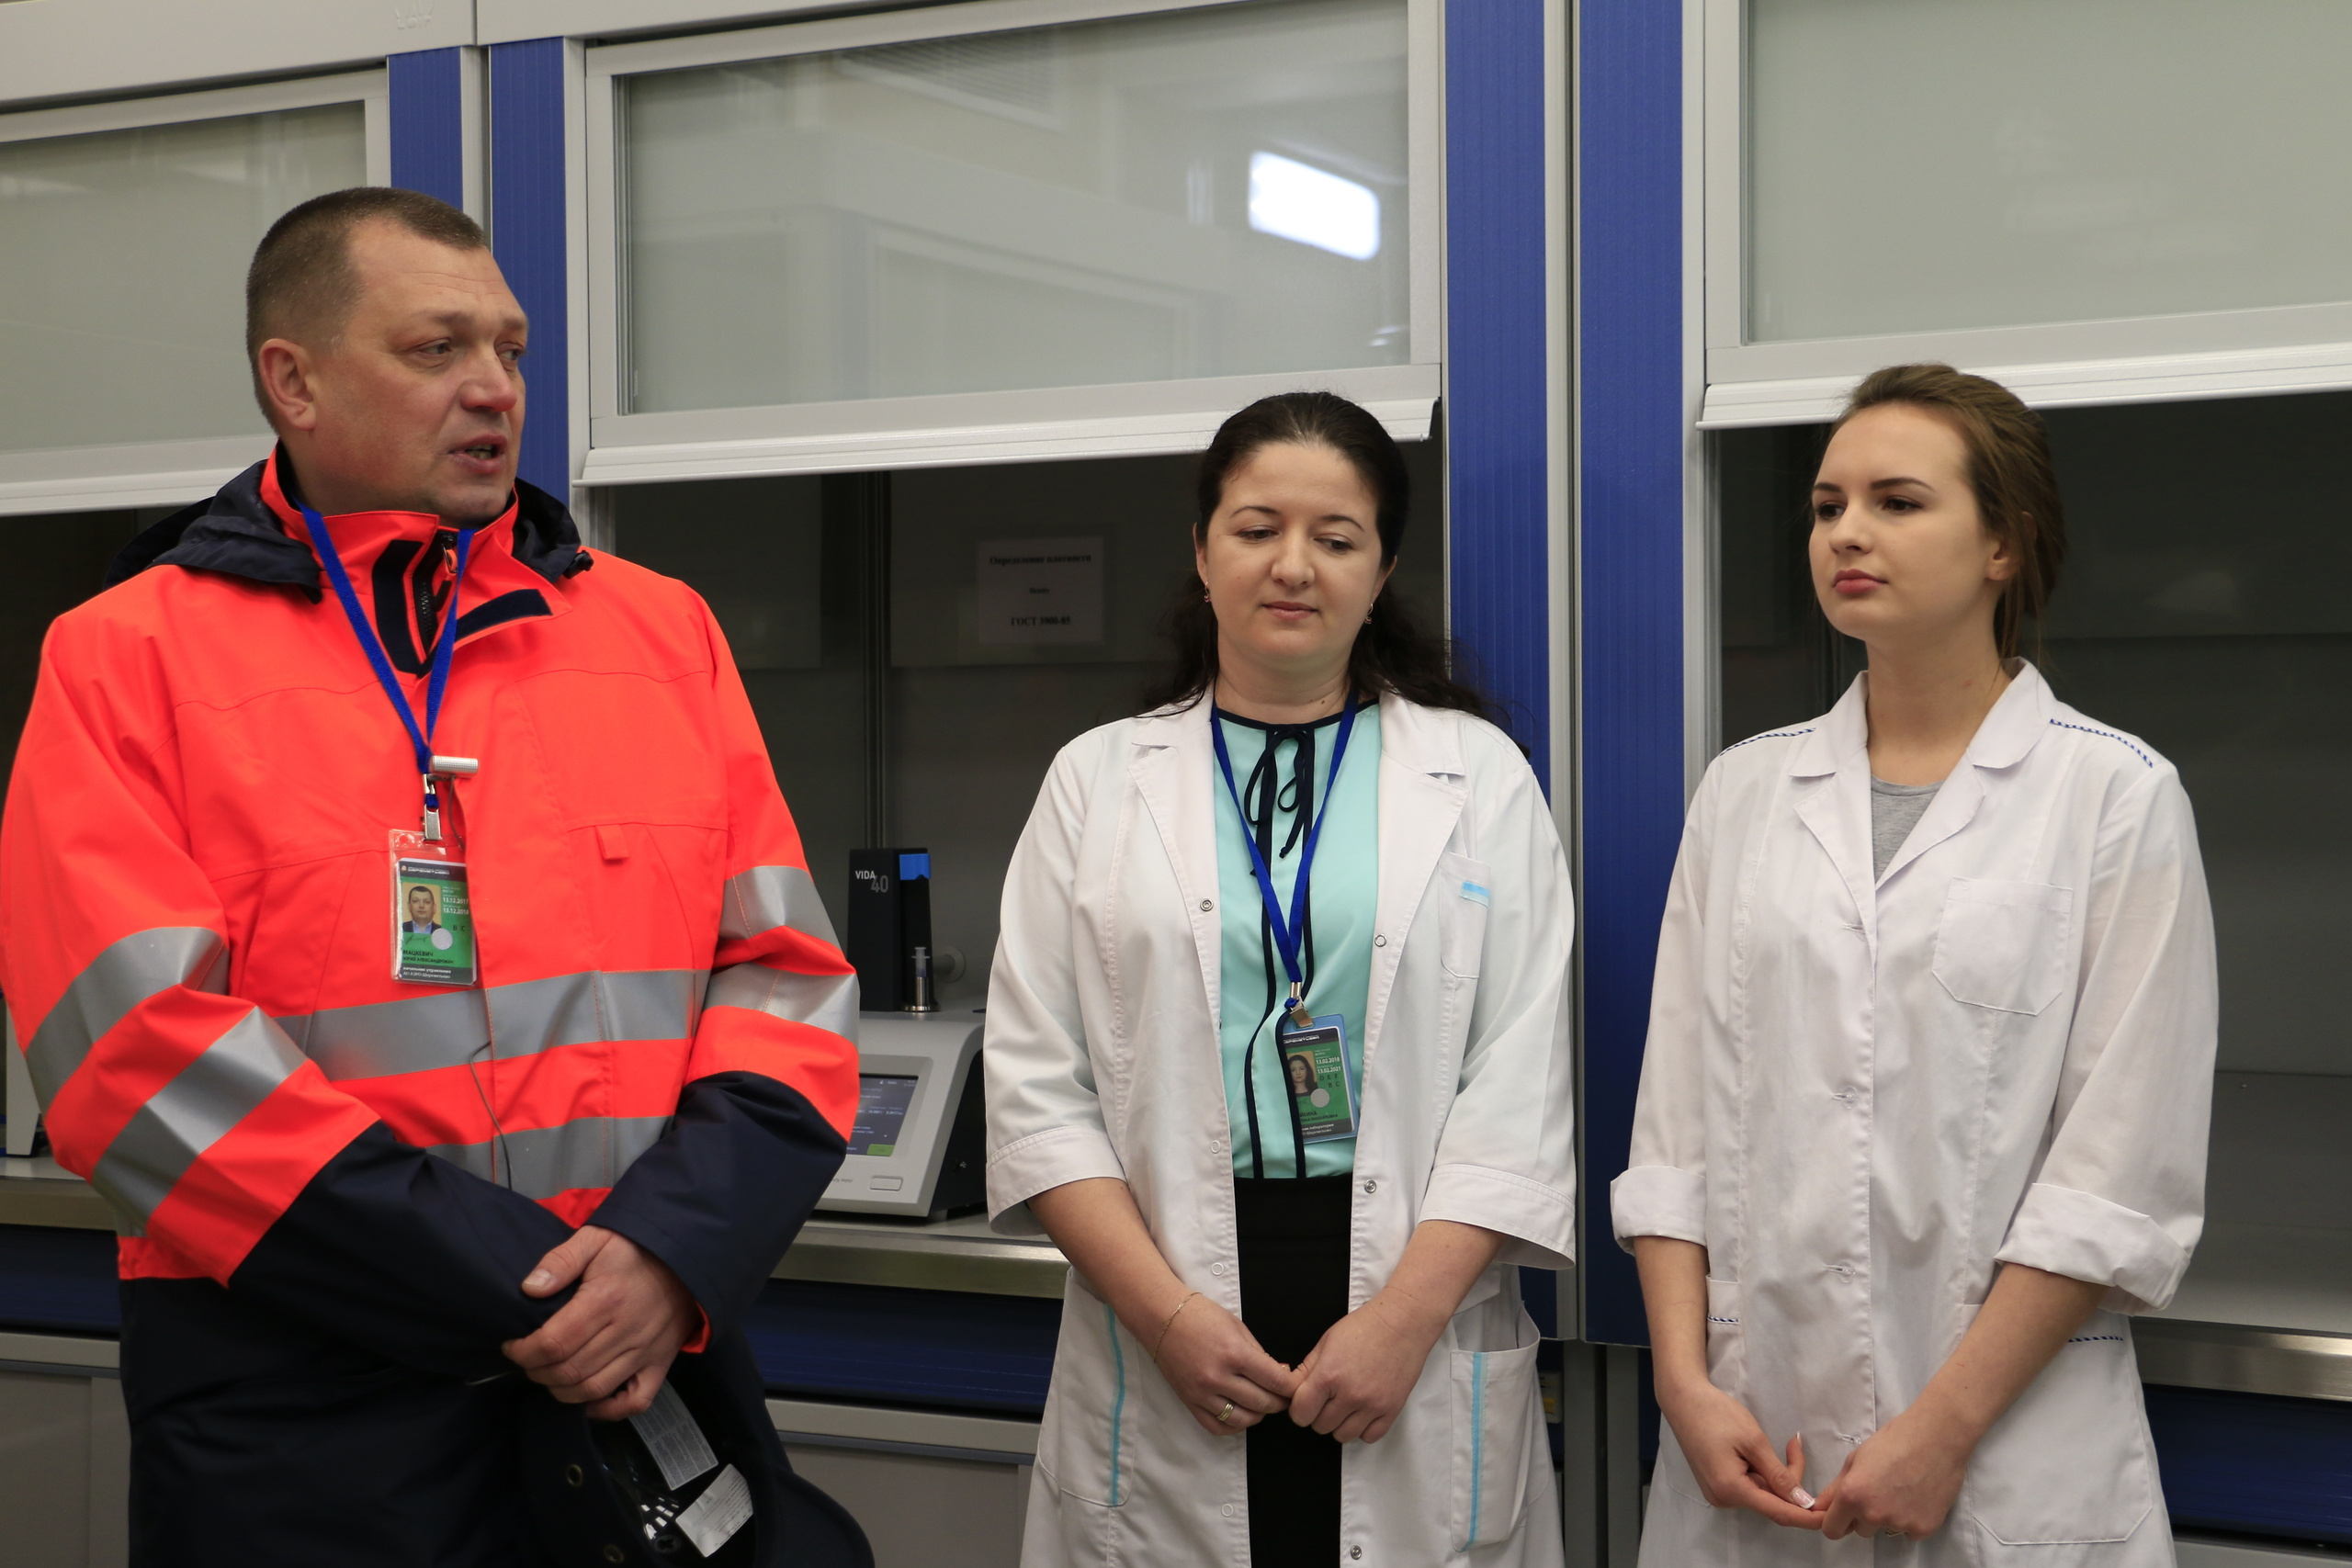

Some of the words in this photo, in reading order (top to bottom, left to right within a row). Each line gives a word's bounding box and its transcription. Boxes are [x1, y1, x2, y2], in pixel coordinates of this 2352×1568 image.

[989, 556, 1045, 567] Определение
[1046, 555, 1091, 563] плотности
[1011, 616, 1037, 626] ГОСТ
[855, 870, 876, 880] VIDA
[871, 875, 888, 893] 40
[443, 897, 469, 905] 13.12.2017
